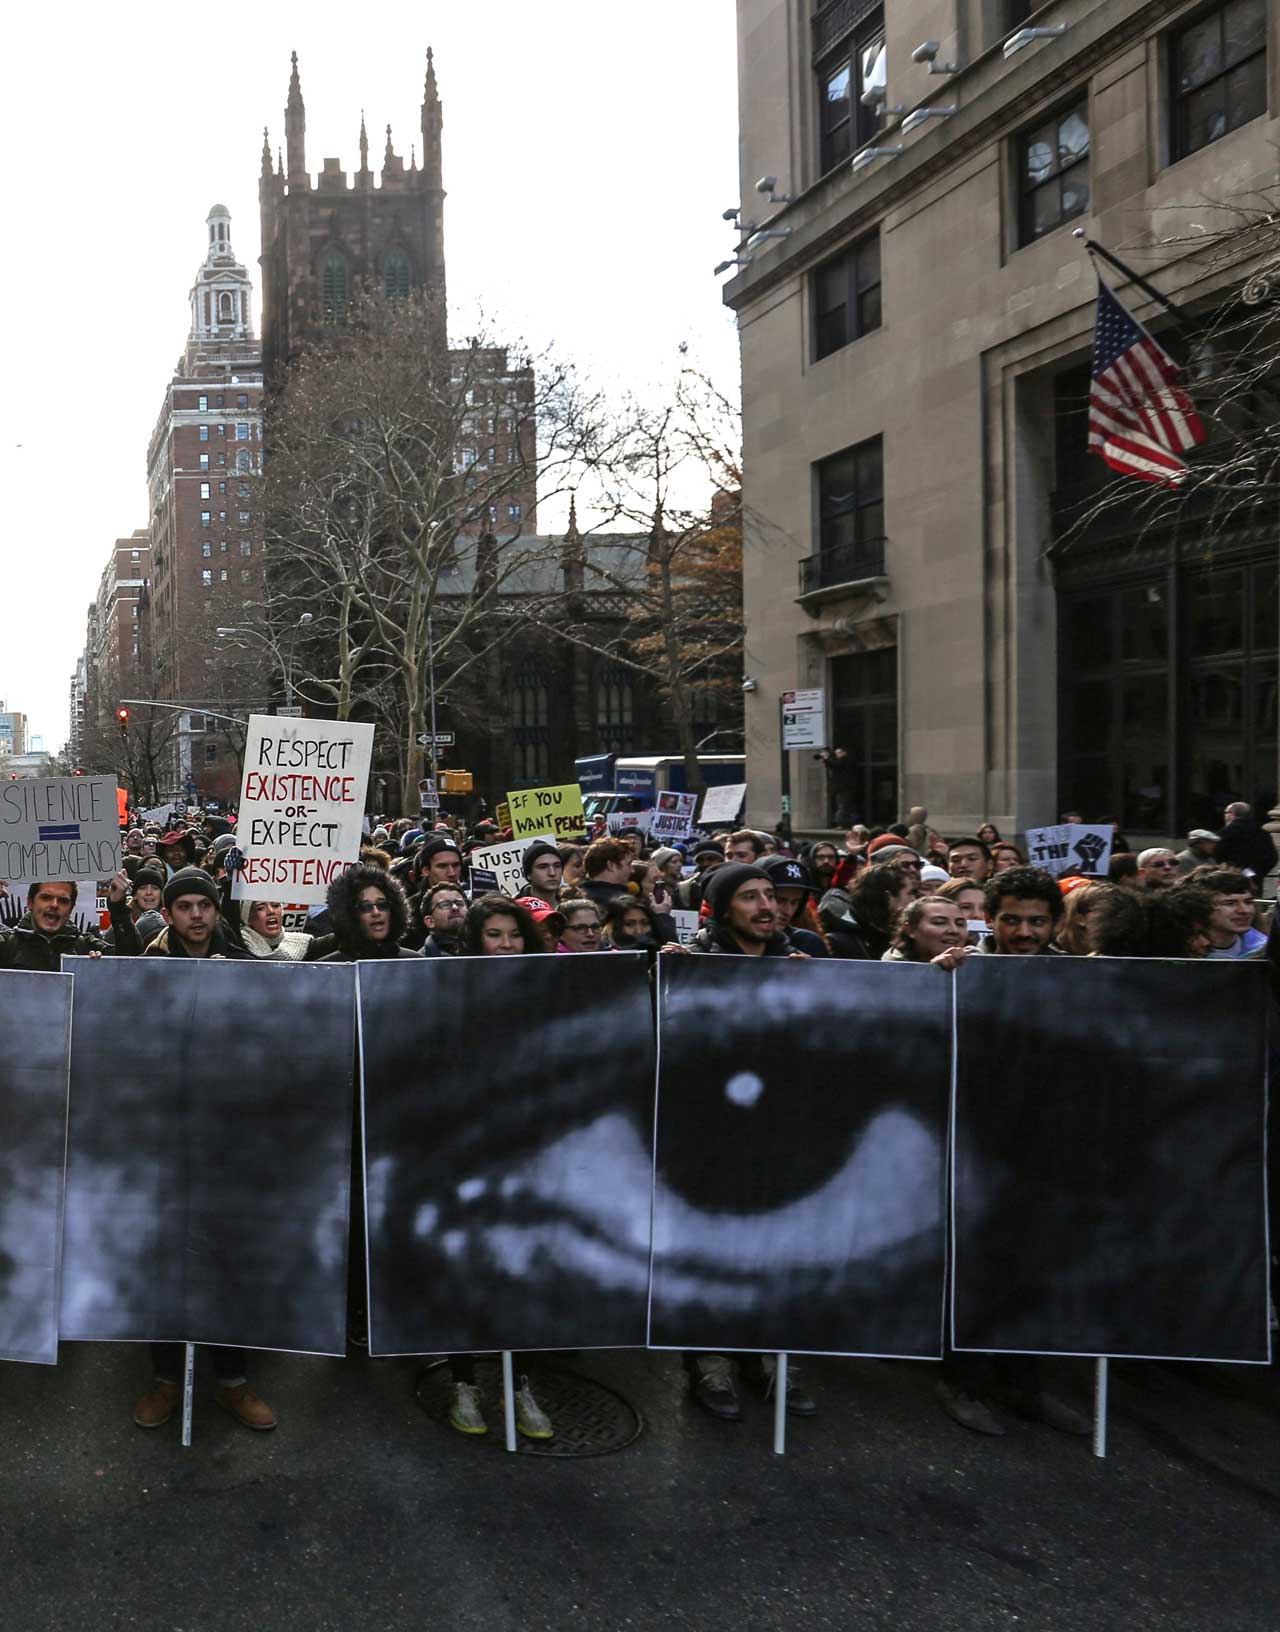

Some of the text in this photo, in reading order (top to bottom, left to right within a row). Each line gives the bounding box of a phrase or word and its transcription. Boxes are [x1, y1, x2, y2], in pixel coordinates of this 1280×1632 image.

[258, 737, 354, 769] RESPECT
[246, 772, 355, 802] EXISTENCE
[3, 782, 103, 824] SILENCE
[512, 792, 562, 809] IF YOU
[251, 819, 338, 847] EXPECT
[515, 814, 553, 833] WANT
[554, 814, 586, 834] PEACE
[655, 815, 691, 831] JUSTICE
[479, 847, 527, 870] JUST
[282, 913, 306, 928] CE
